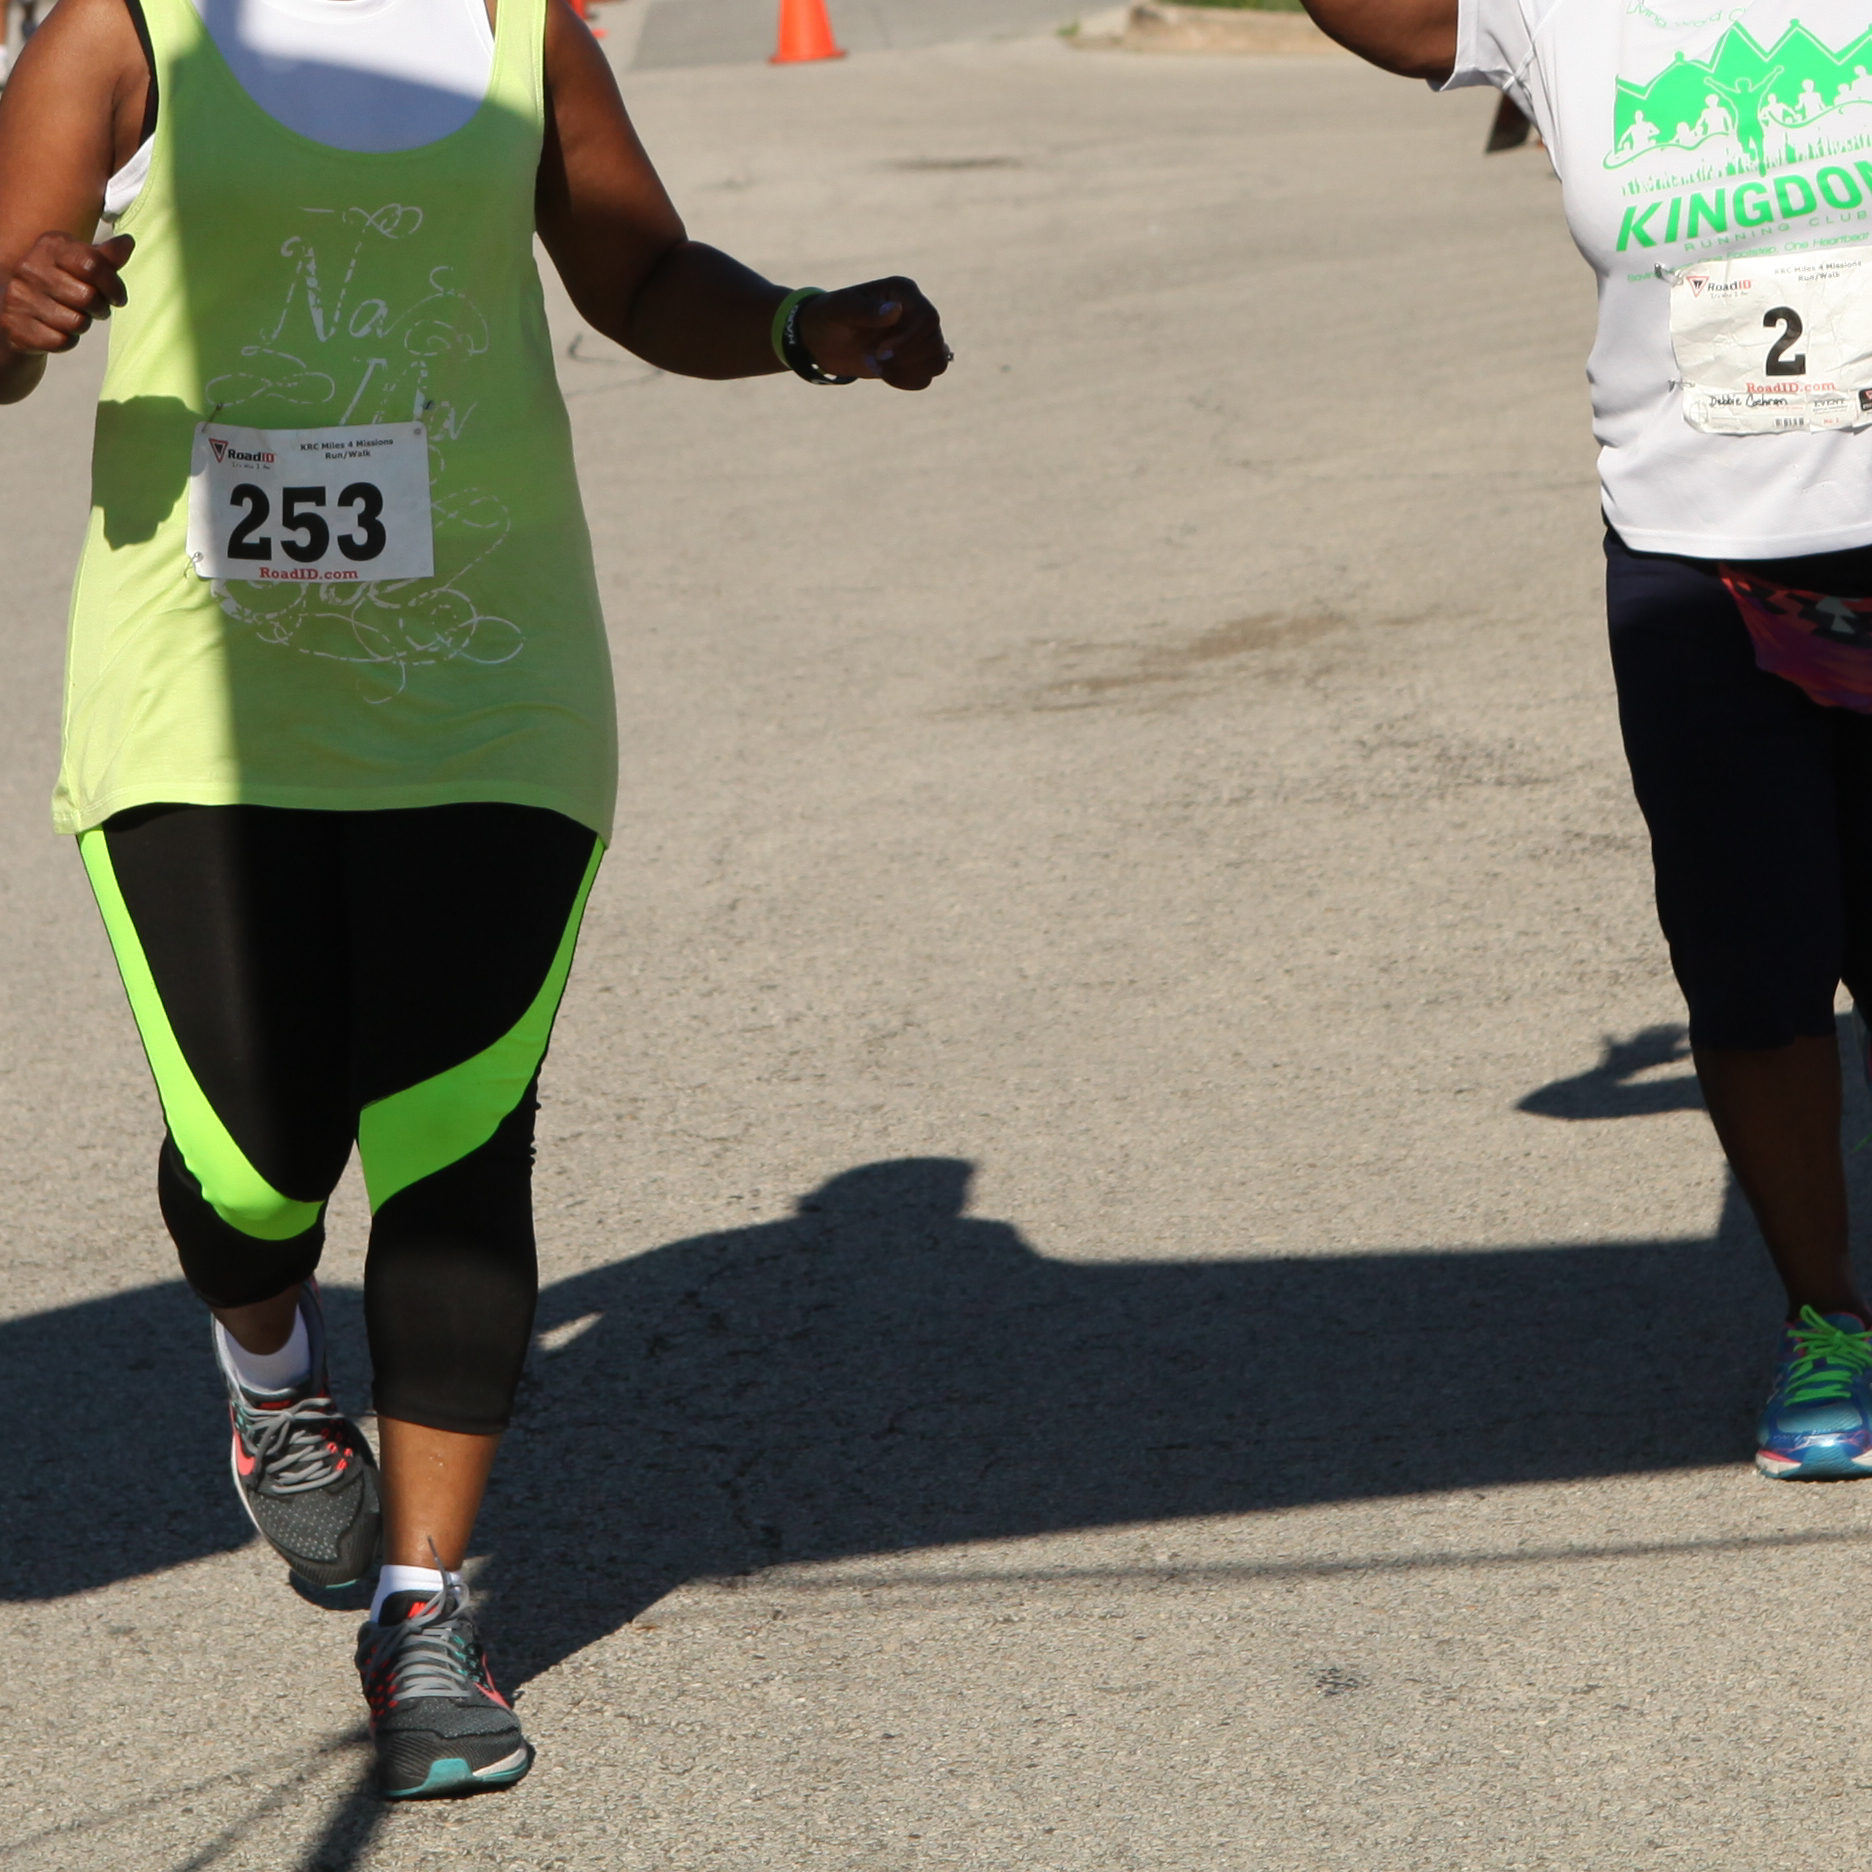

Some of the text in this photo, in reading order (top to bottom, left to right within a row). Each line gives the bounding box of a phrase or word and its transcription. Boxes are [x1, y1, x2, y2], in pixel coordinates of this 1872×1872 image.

[1684, 209, 1867, 252] RUNNING CLUB
[1784, 241, 1809, 252] One
[1813, 231, 1869, 247] Heartbeat
[1707, 279, 1752, 292] RoadID
[1763, 306, 1806, 377] 2
[1746, 381, 1837, 393] RoadID.com
[300, 438, 394, 451] KRC Miles 4 Missions
[228, 449, 275, 463] RoadID
[325, 449, 371, 460] Run/Walk
[227, 482, 387, 563] 253
[259, 567, 359, 579] RoadID.com
